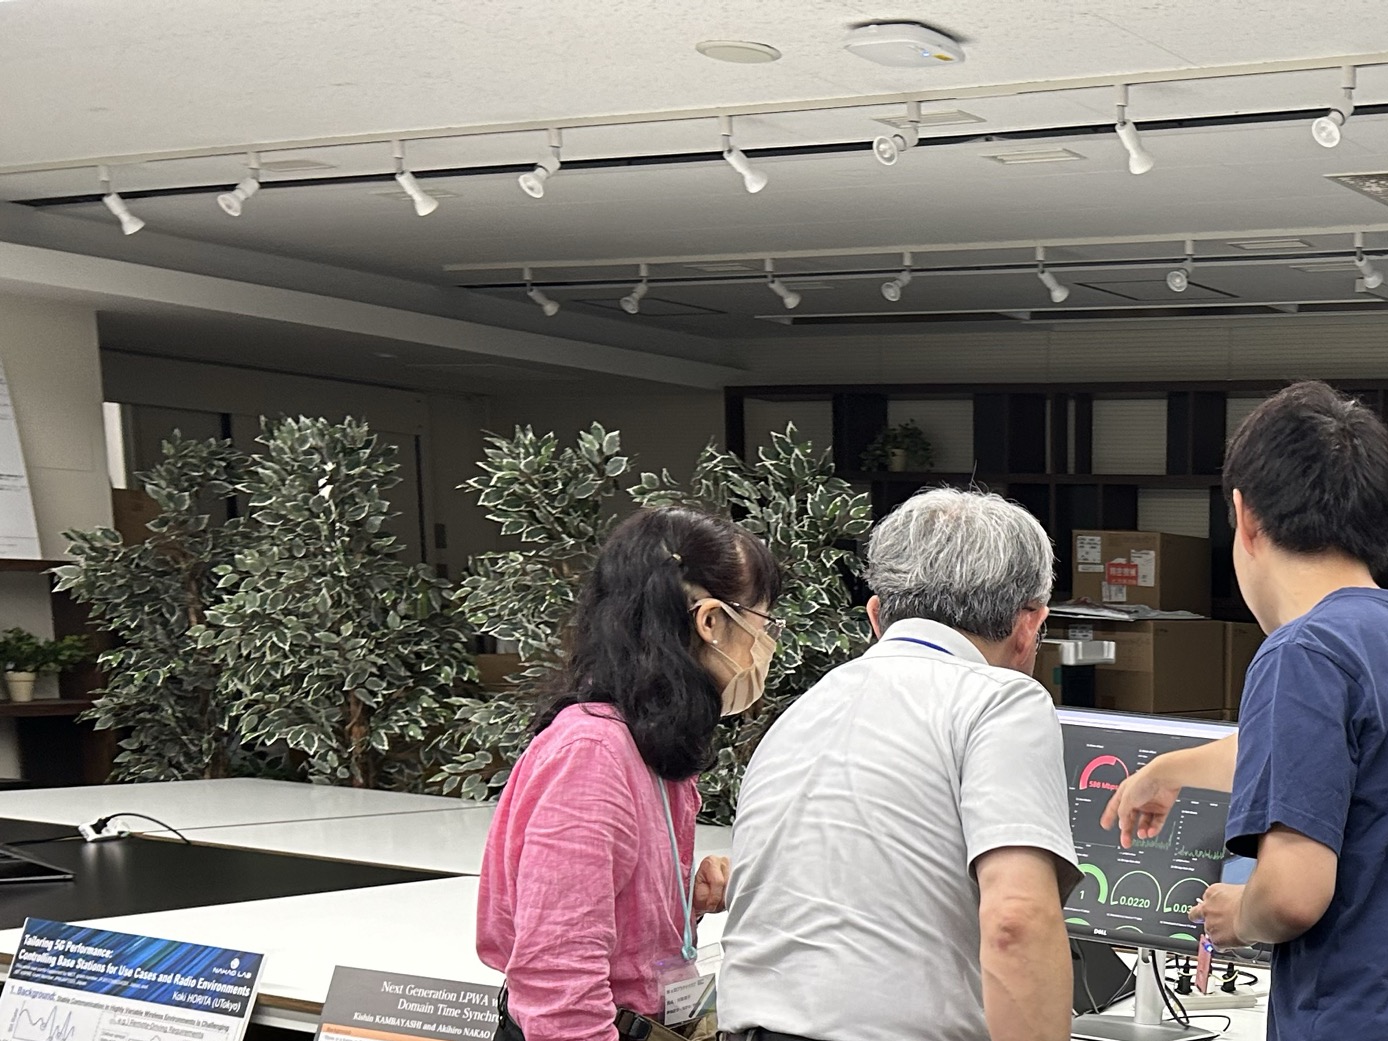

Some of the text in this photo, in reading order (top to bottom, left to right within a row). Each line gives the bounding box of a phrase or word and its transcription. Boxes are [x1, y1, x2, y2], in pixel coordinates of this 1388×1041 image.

[1079, 890, 1085, 900] 1
[1119, 896, 1150, 909] 0.0220
[1093, 928, 1107, 936] DELL
[22, 934, 114, 958] Tailoring 5G Performance:
[18, 948, 57, 967] Controlling
[57, 955, 75, 967] Base
[76, 958, 106, 973] Stations
[106, 962, 118, 974] for
[118, 965, 133, 977] Use
[134, 967, 157, 981] Cases
[157, 971, 173, 983] and
[174, 973, 197, 987] Radio
[197, 977, 251, 996] Environments
[172, 990, 241, 1013] Koki HORITA (UTokyo)
[381, 981, 404, 994] Next
[405, 984, 457, 1001] Generation
[459, 991, 489, 1005] LPWA
[397, 998, 434, 1014] Domain
[436, 1003, 461, 1017] Time
[353, 1011, 374, 1022] Kishin
[375, 1015, 422, 1029] KAMBAYASHI
[423, 1021, 436, 1031] and
[437, 1023, 463, 1035] Akihiro
[463, 1027, 490, 1039] NAKAO
